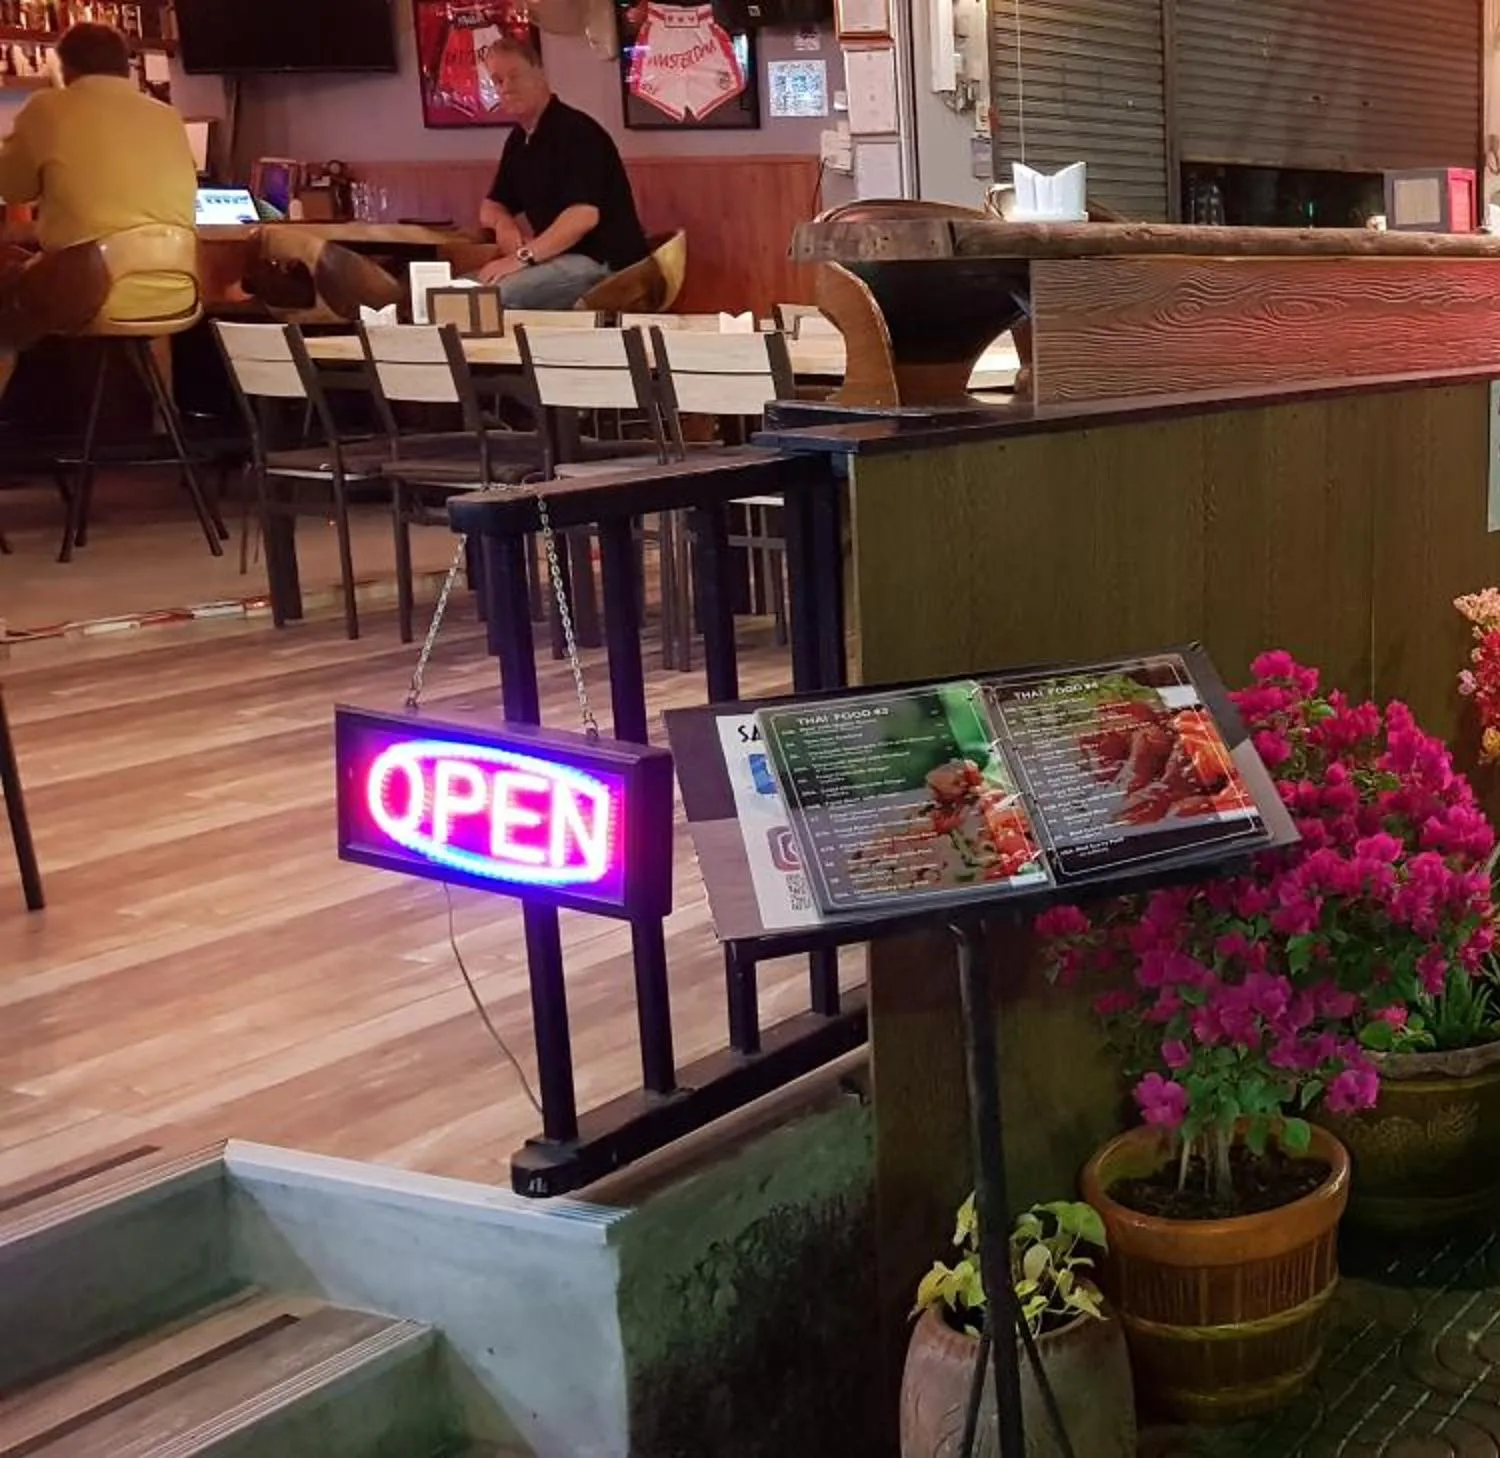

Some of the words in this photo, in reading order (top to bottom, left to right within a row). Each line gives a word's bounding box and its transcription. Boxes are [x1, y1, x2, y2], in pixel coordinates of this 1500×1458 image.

[1013, 691, 1044, 701] THAI
[1048, 684, 1082, 695] FOOD
[798, 716, 829, 727] THAI
[834, 710, 871, 722] FOOD
[368, 745, 610, 880] OPEN
